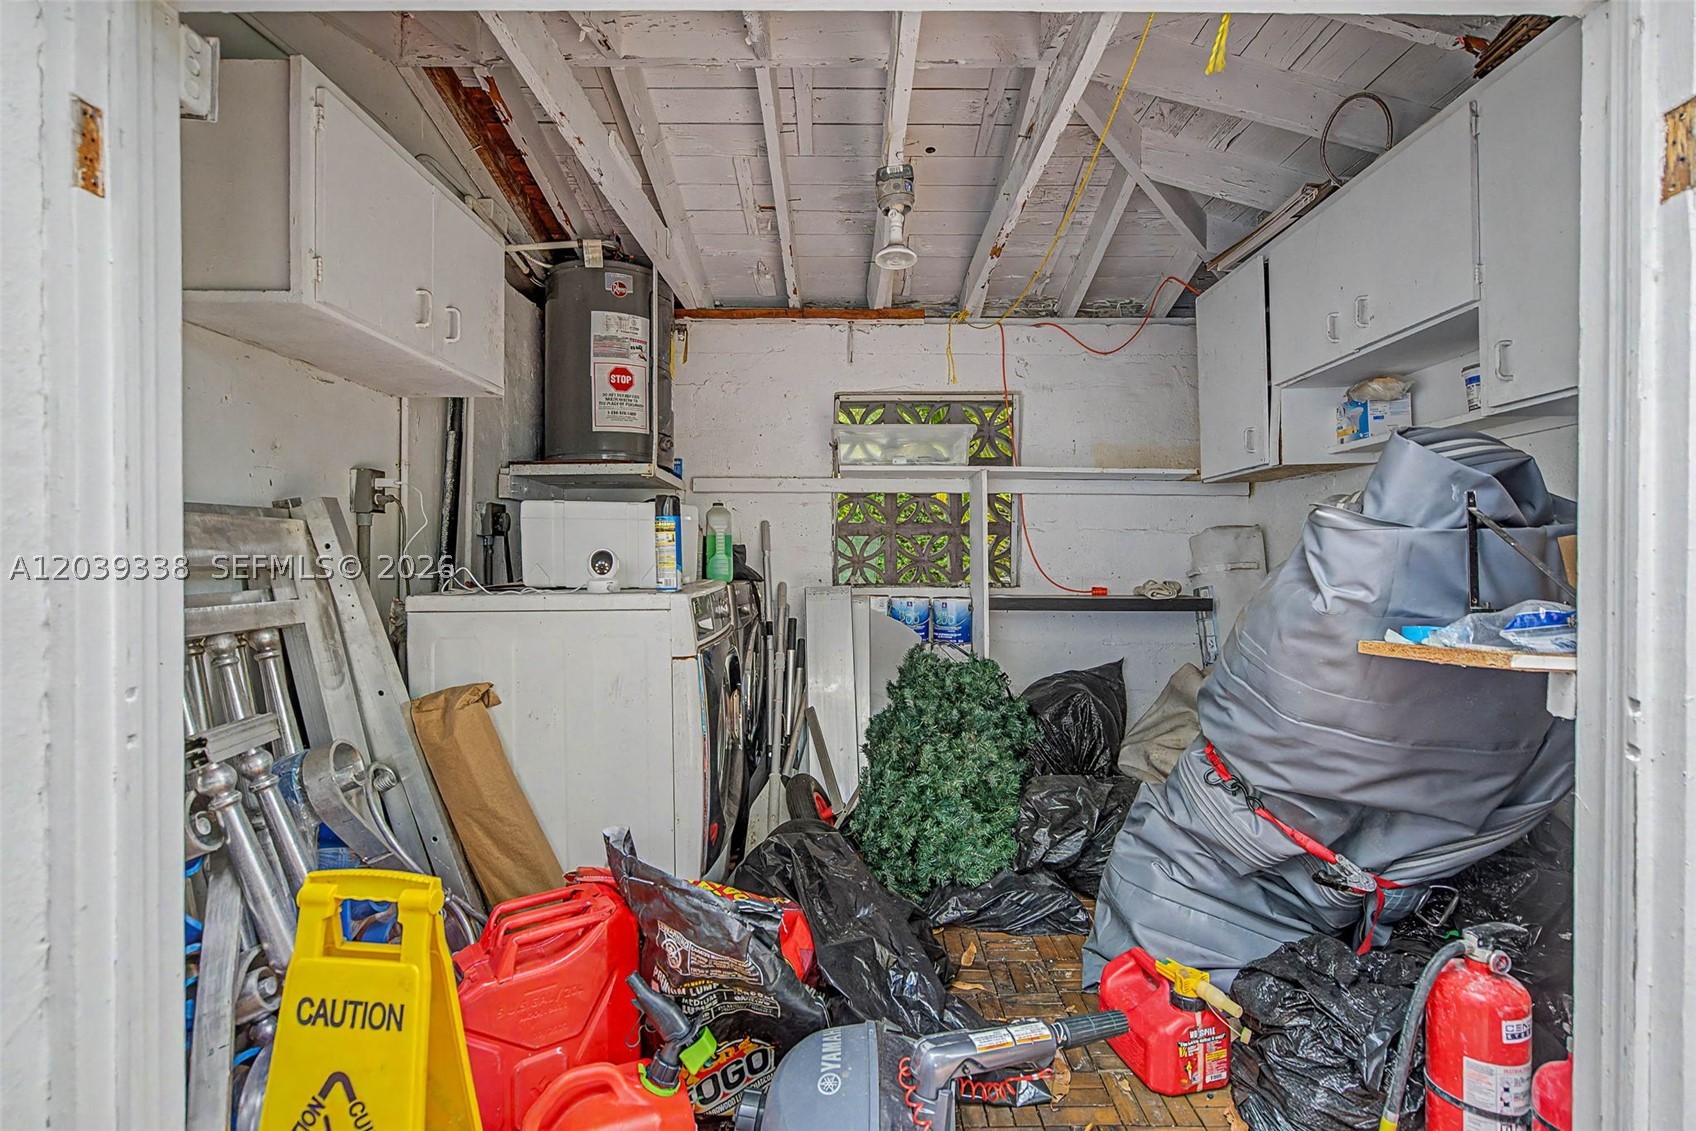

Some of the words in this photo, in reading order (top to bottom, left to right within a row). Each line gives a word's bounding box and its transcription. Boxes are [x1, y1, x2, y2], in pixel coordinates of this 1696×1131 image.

[610, 374, 632, 384] STOP
[689, 981, 719, 998] LUMP
[296, 997, 405, 1032] CAUTION
